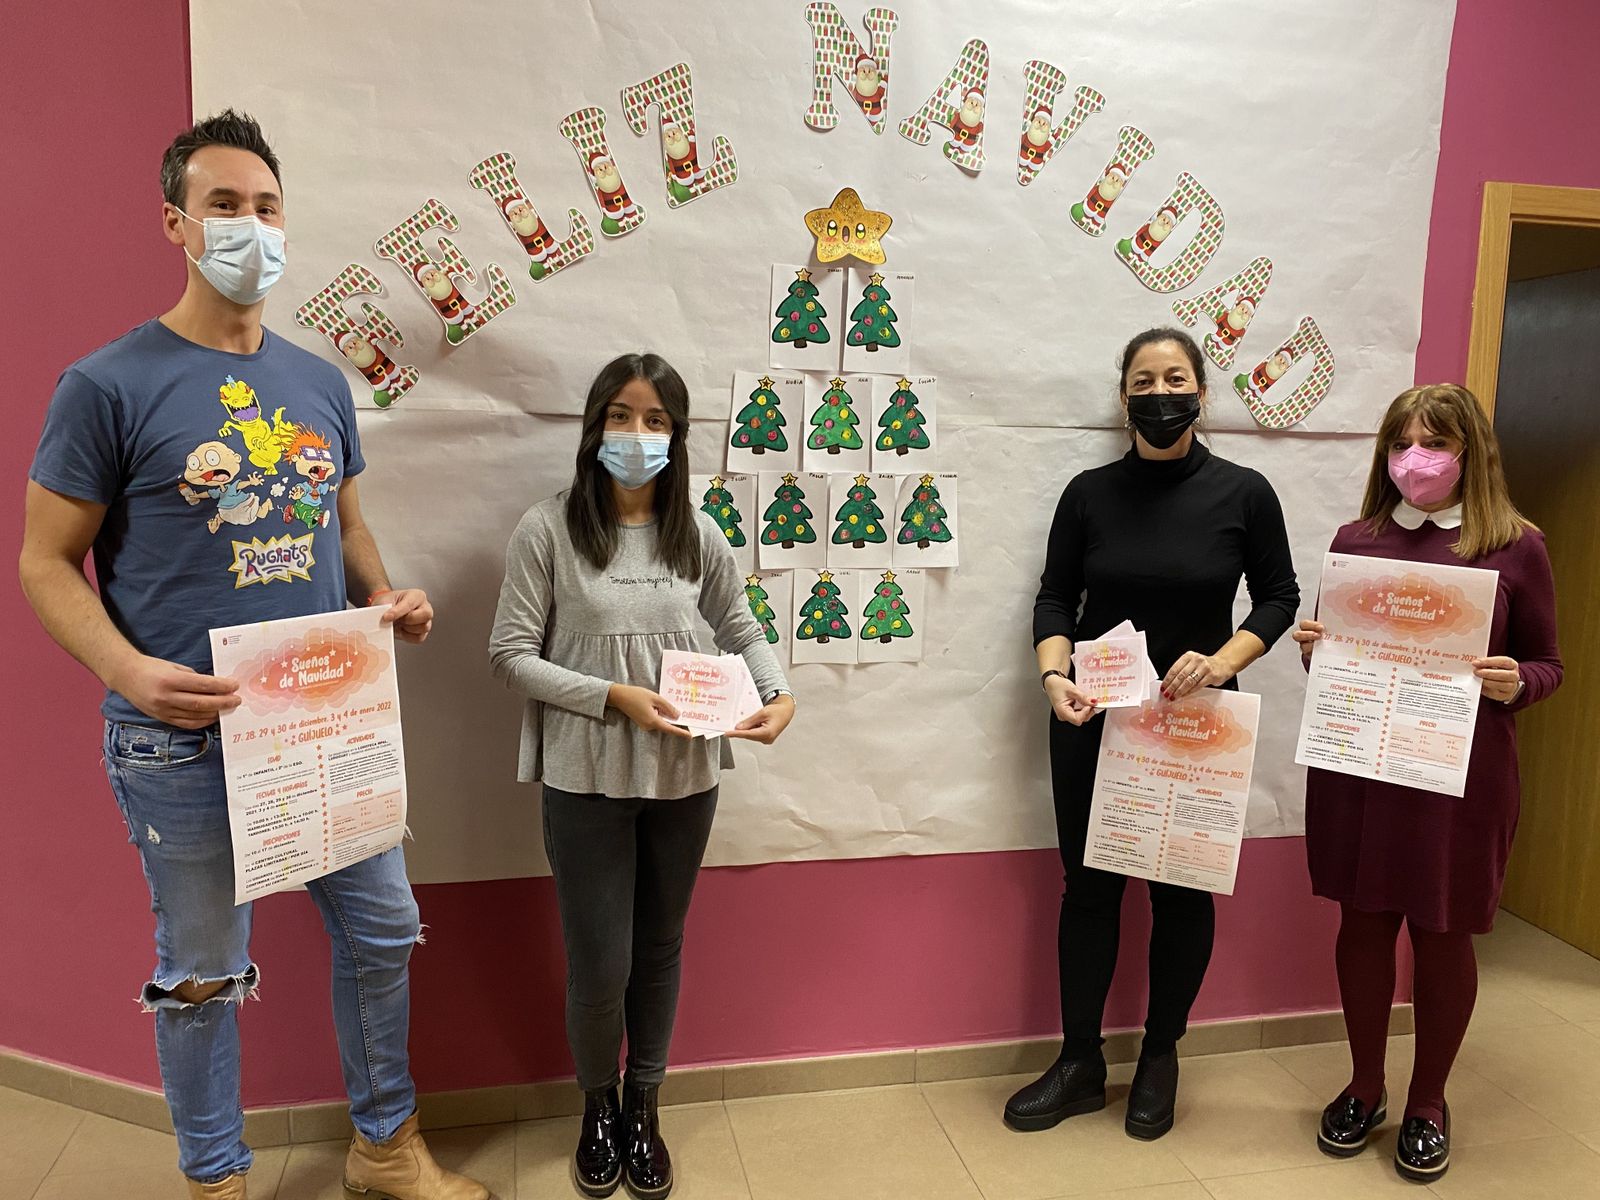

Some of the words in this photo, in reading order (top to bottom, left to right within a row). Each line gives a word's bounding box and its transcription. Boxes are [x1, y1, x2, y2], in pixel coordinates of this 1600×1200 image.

[803, 1, 1335, 428] NAVIDAD
[294, 62, 739, 408] FELIZ
[1386, 592, 1424, 608] Sueños
[1372, 602, 1386, 614] de
[1389, 603, 1436, 621] Navidad
[1345, 636, 1353, 644] 29
[1355, 638, 1360, 646] y
[1361, 638, 1370, 647] 30
[1412, 645, 1417, 653] 3
[1418, 647, 1423, 655] y
[1424, 647, 1430, 655] 4
[291, 655, 330, 673] Sueños
[279, 673, 294, 689] de
[298, 664, 344, 687] Navidad
[258, 727, 268, 737] 29
[270, 727, 275, 736] y
[277, 723, 286, 733] 30
[288, 721, 296, 730] de
[330, 712, 335, 721] 3
[336, 713, 341, 721] y
[343, 709, 347, 718] 4
[349, 707, 356, 716] de
[359, 706, 375, 714] enero
[377, 701, 391, 711] 2022
[1166, 713, 1200, 727] Sueños
[1152, 723, 1165, 734] de
[1168, 725, 1210, 741] Navidad
[1229, 770, 1243, 779] 2022
[255, 856, 273, 865] CENTRO
[274, 849, 297, 859] CULTURAL
[245, 864, 262, 873] PLAZAS
